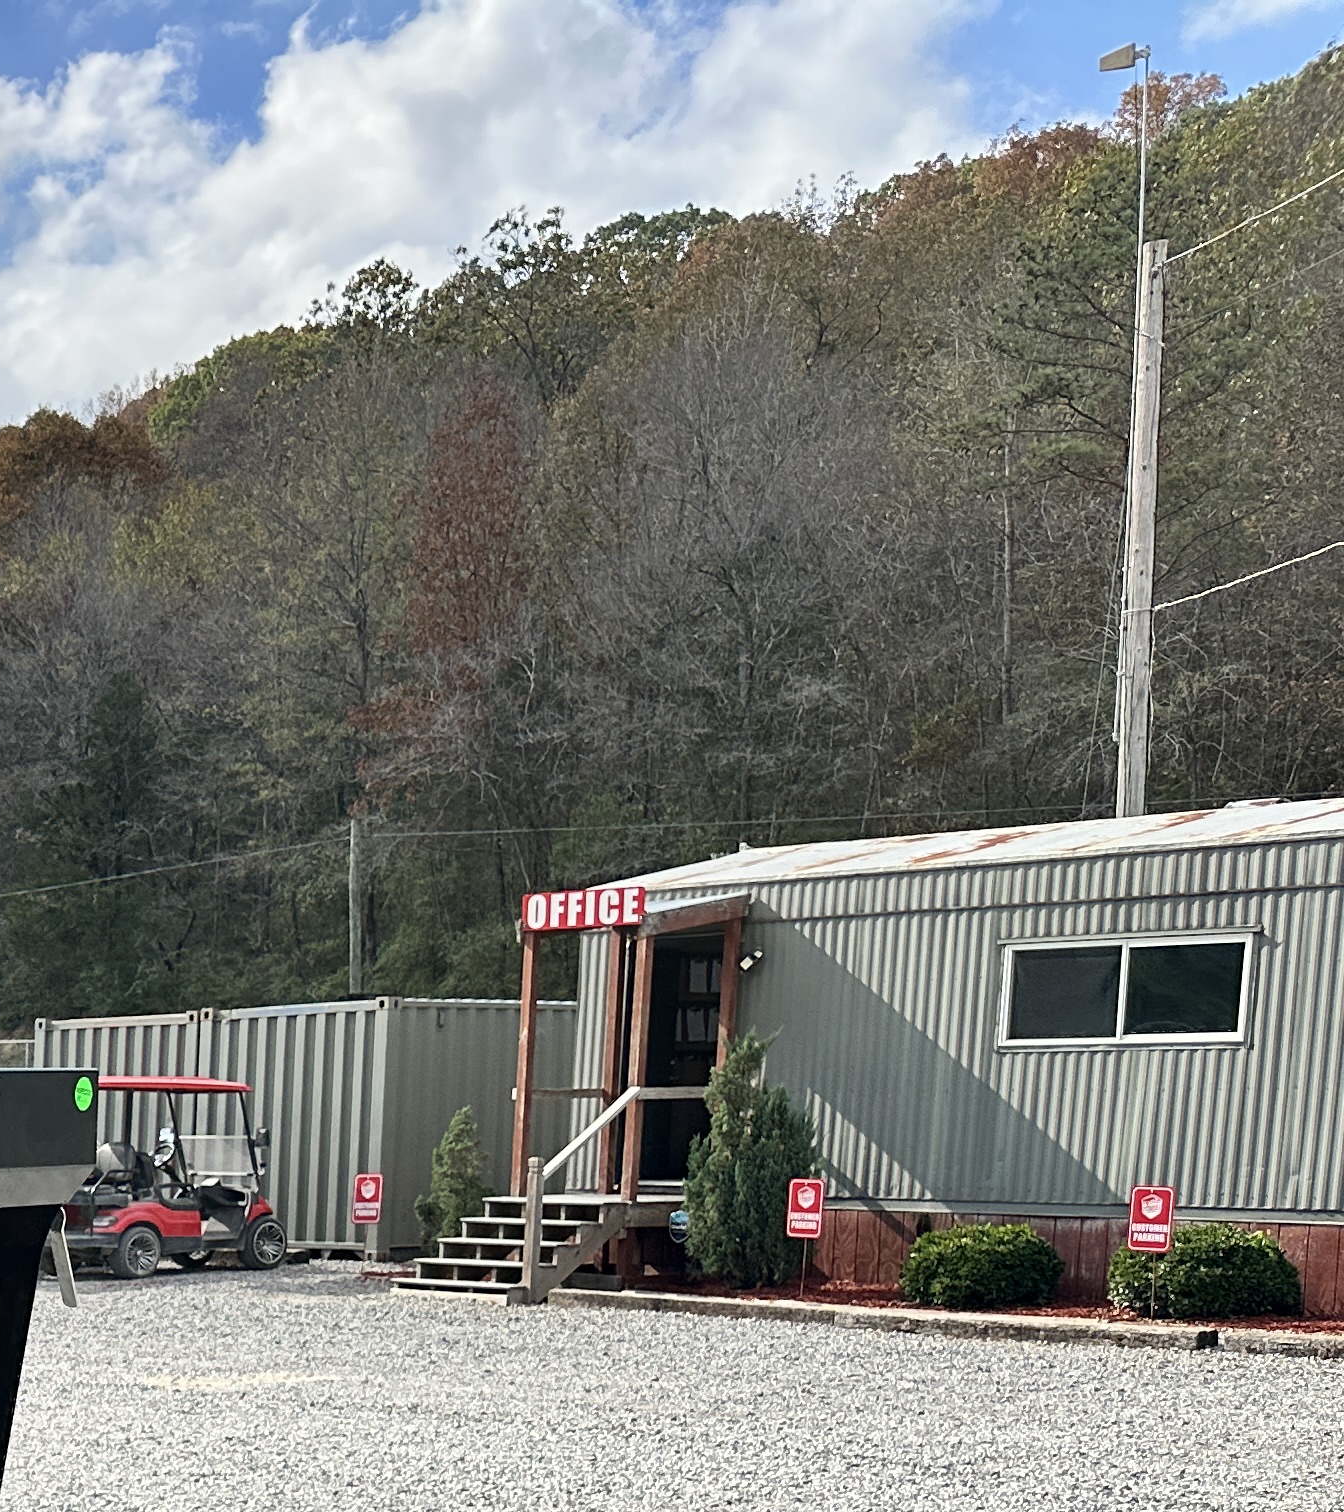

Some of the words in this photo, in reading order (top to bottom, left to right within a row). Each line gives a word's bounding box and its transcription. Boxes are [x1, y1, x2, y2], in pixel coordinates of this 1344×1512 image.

[527, 888, 639, 929] OFFICE
[1131, 1223, 1169, 1233] CUSTOMER
[1132, 1232, 1166, 1243] PARKING
